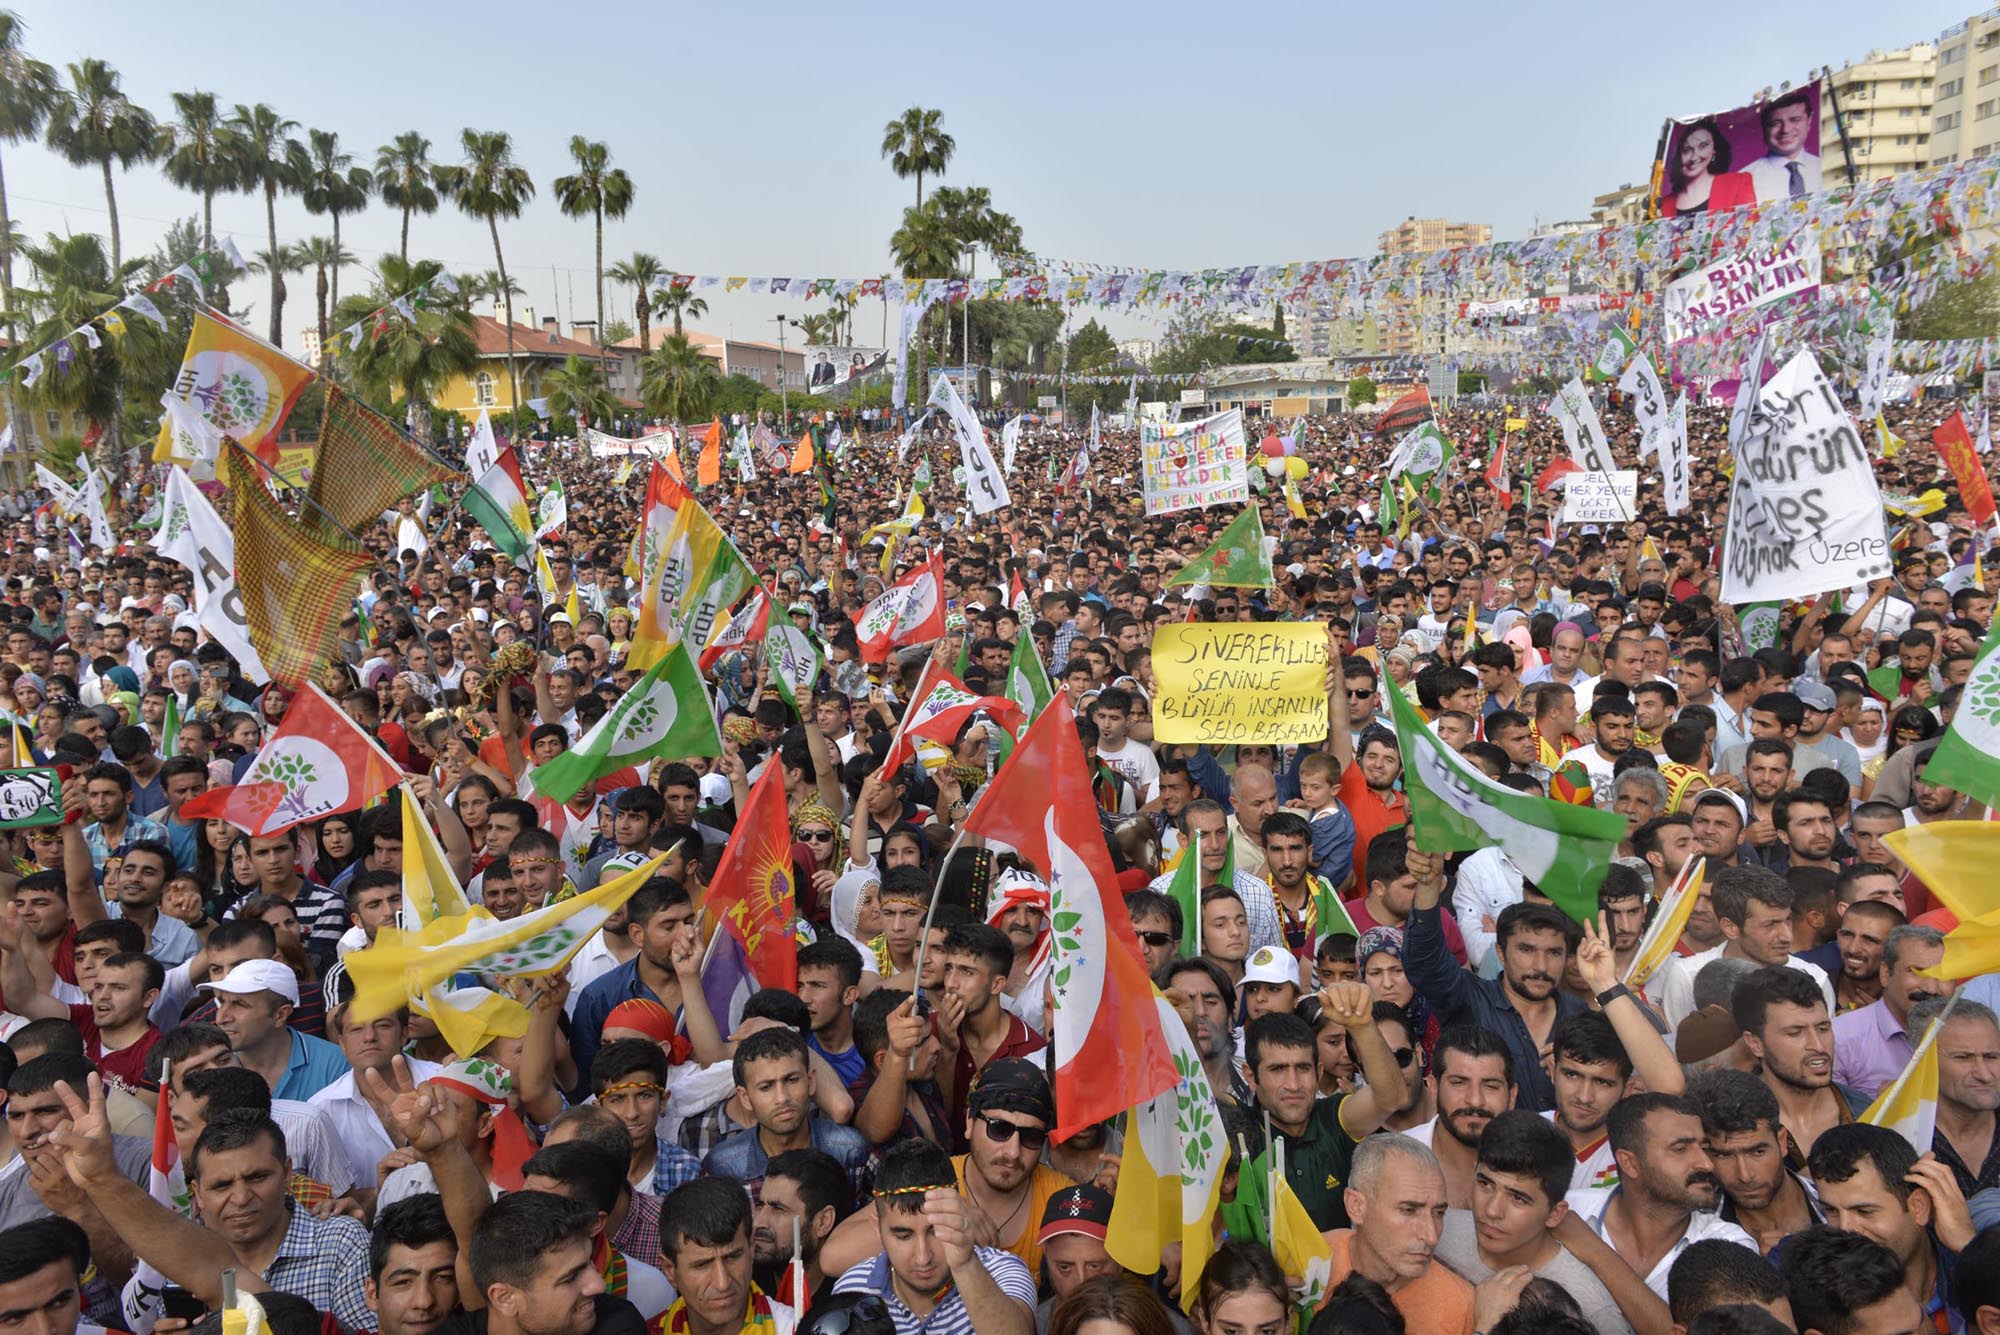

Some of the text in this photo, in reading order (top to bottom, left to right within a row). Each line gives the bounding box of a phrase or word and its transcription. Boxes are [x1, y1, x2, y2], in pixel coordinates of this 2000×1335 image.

[175, 369, 199, 401] HD
[1577, 423, 1602, 472] HD
[1176, 464, 1232, 487] KADAR
[1570, 485, 1591, 495] HER
[198, 546, 250, 626] HD
[660, 558, 680, 604] HDP
[692, 602, 716, 647] HDP
[1162, 693, 1236, 719] BÜYÜK
[1195, 719, 1247, 741] SELO
